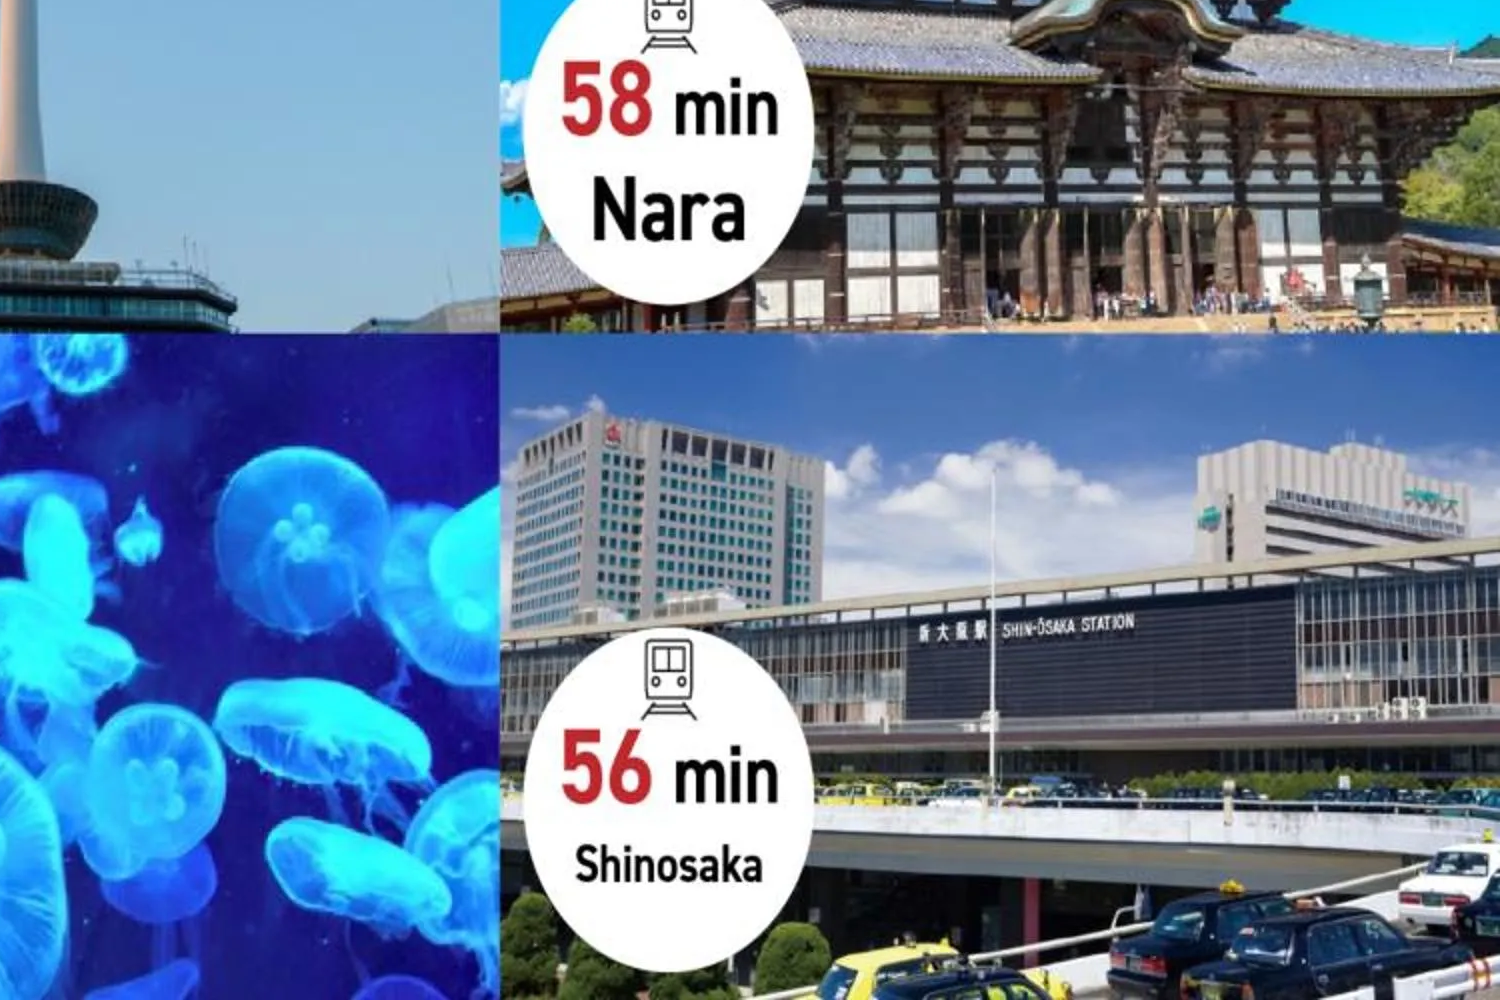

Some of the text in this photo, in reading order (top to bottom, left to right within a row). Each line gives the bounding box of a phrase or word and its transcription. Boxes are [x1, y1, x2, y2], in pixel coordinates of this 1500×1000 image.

[918, 618, 988, 644] 新大阪駅
[1080, 612, 1136, 633] STATION
